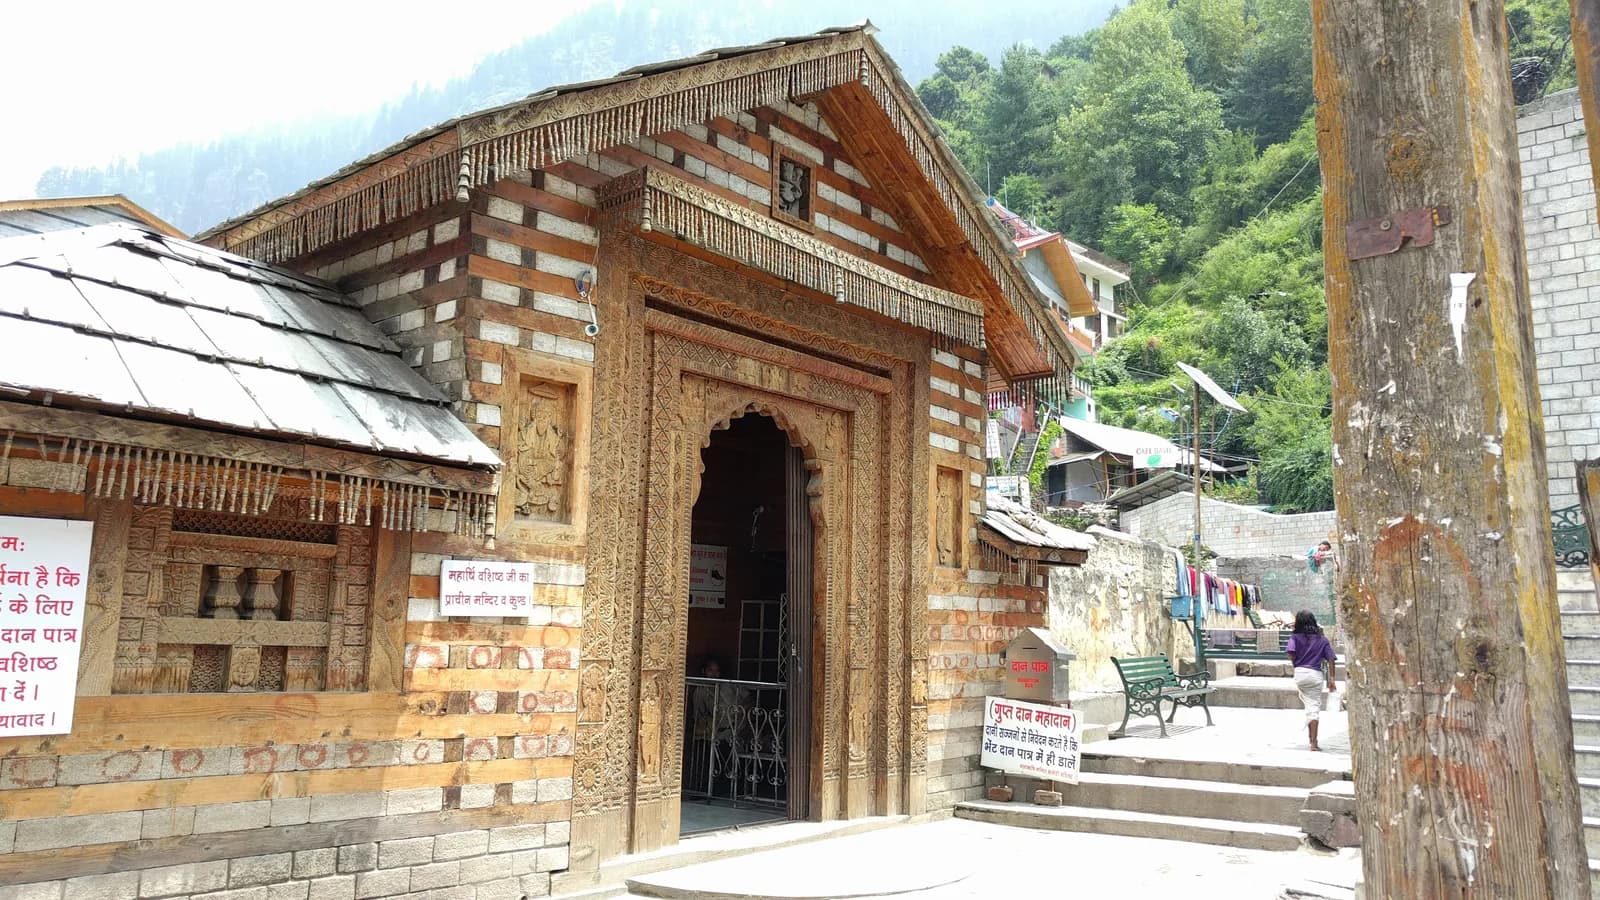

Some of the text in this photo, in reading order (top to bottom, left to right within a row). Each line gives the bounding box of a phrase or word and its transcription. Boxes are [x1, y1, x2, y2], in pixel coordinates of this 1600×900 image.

[34, 565, 49, 588] है
[56, 566, 80, 587] कि
[506, 569, 516, 582] जी
[519, 572, 530, 582] का
[9, 593, 28, 614] के
[36, 594, 73, 616] लिए
[445, 591, 471, 607] प्राचीन
[474, 591, 498, 606] मन्दिर
[501, 595, 507, 605] व
[1, 628, 77, 643] दान पात्र
[1011, 661, 1049, 673] दान पात्र
[13, 680, 26, 701] दें
[1016, 706, 1033, 723] दान
[984, 738, 1076, 769] भेंट दान पात्र में ही डालें
